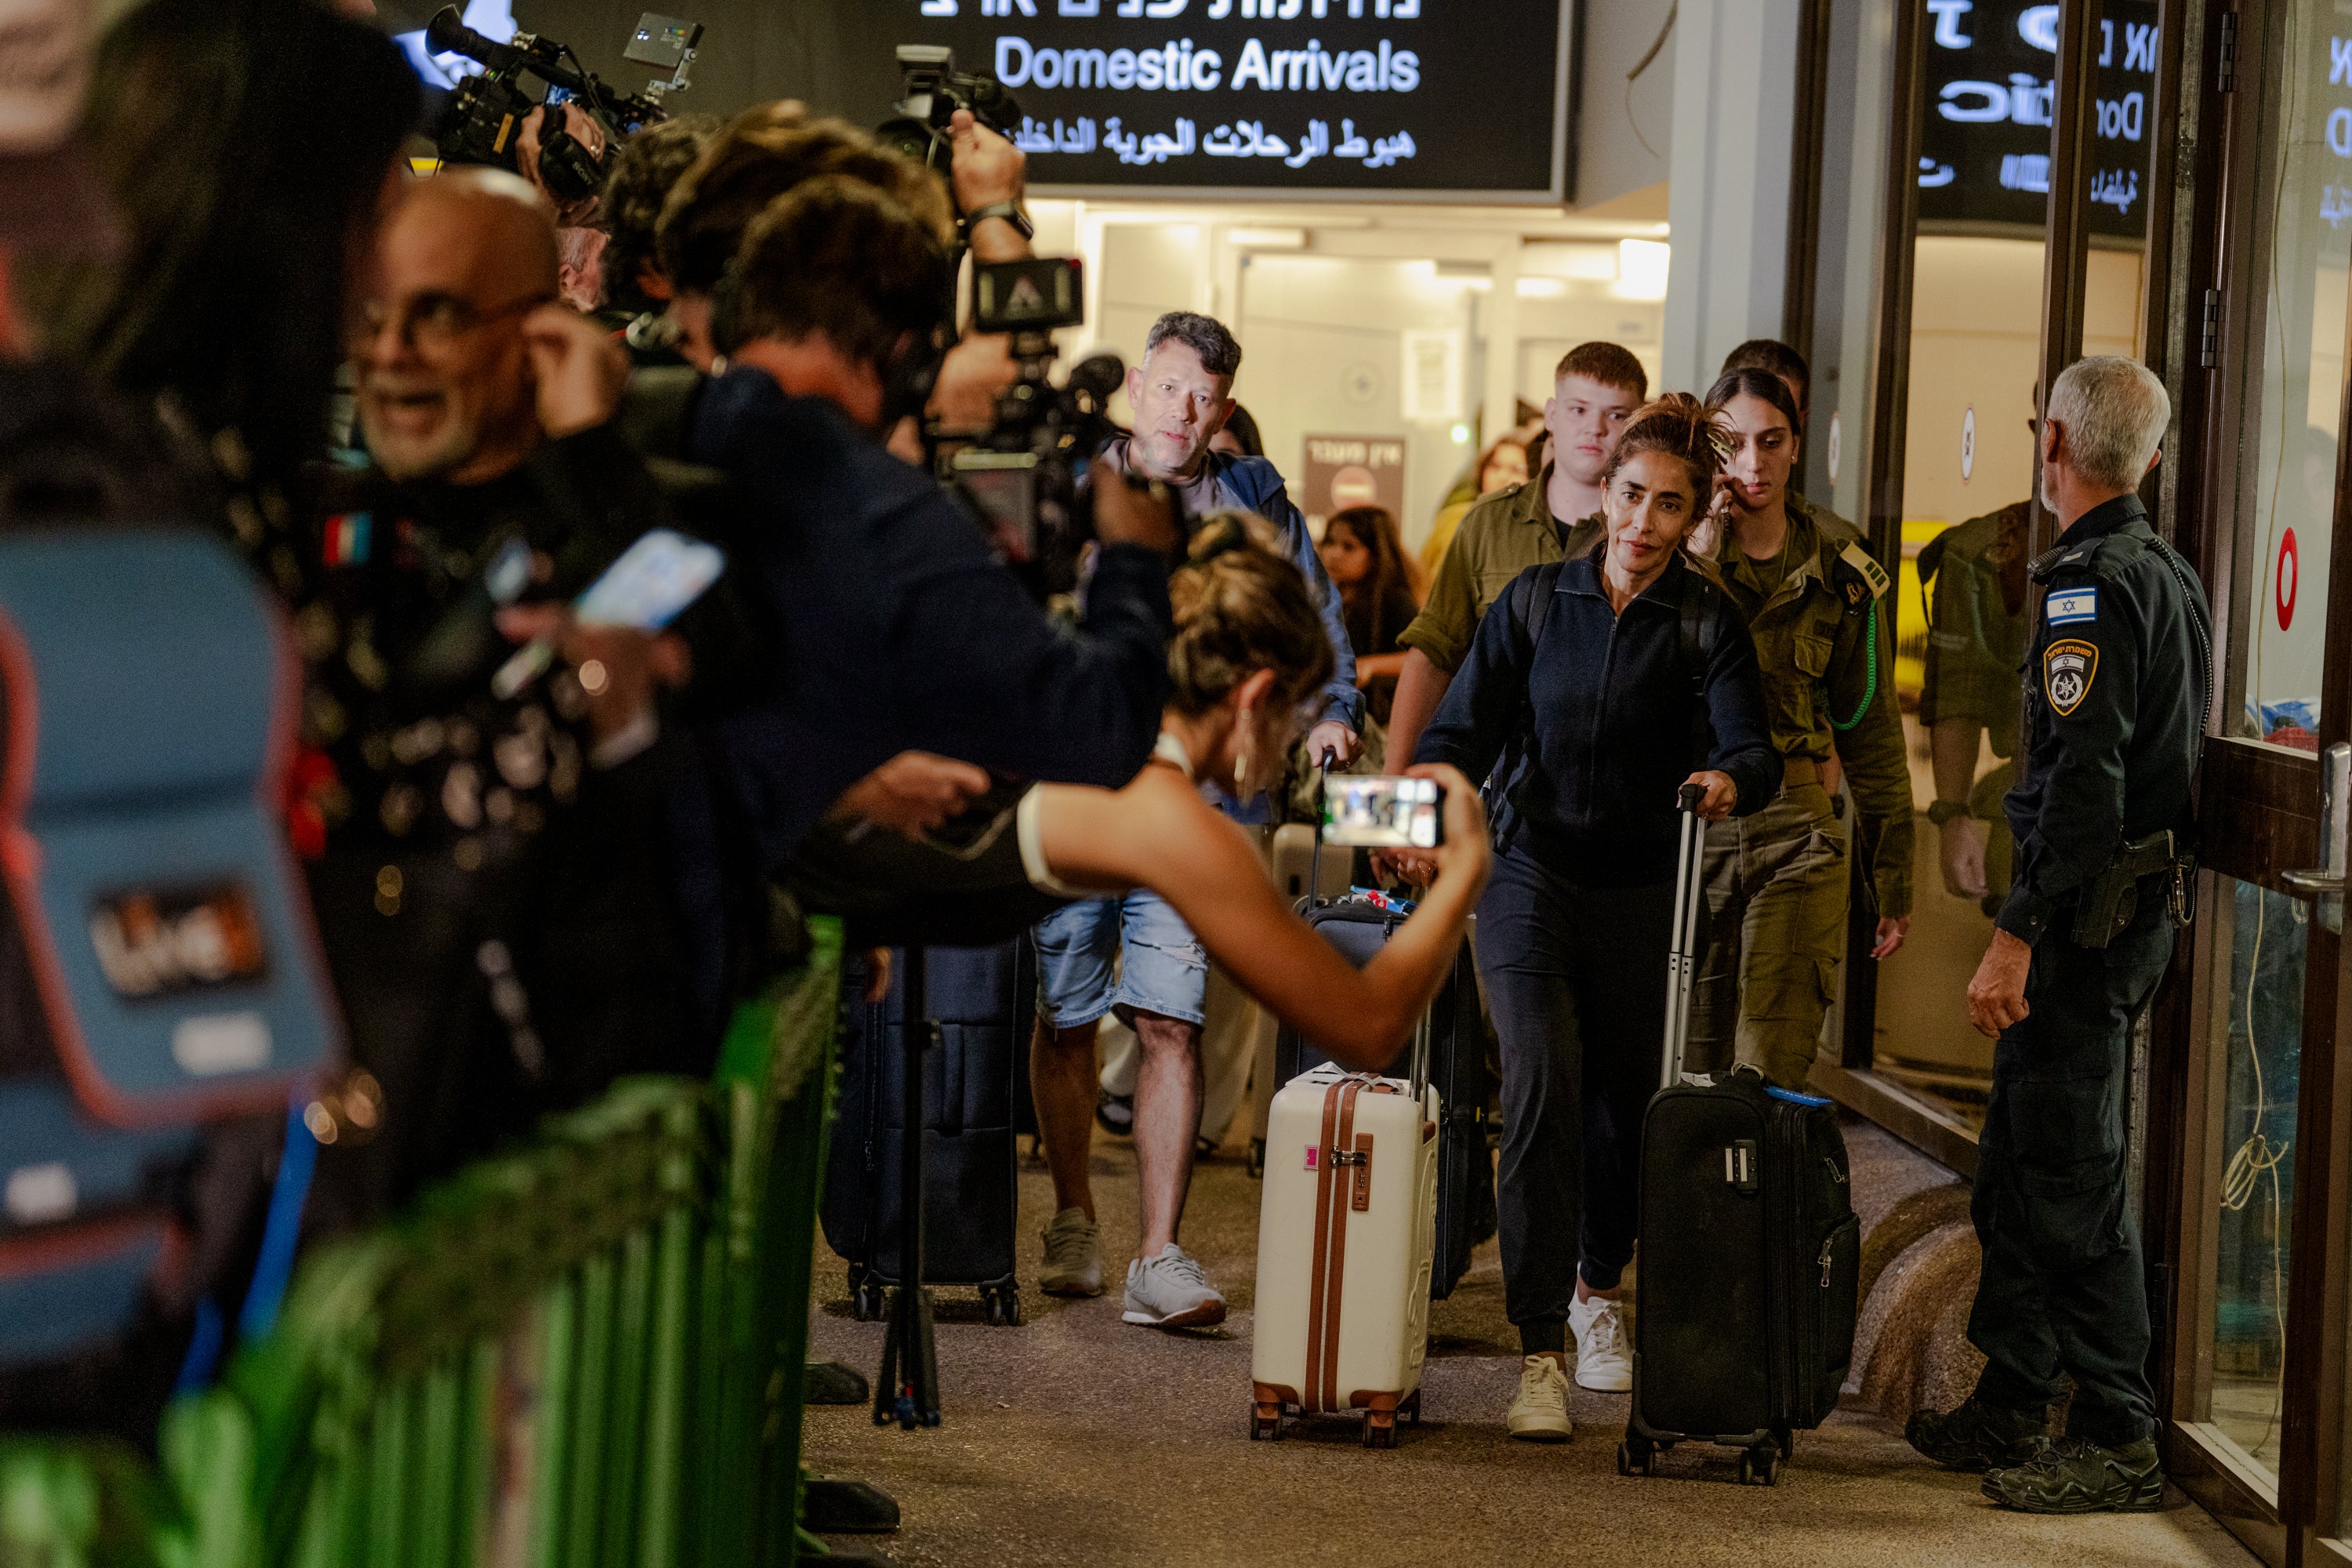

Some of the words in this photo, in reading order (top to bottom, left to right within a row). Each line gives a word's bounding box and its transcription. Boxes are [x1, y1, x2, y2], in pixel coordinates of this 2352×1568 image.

[995, 36, 1222, 91] Domestic
[1231, 38, 1421, 92] Arrivals
[1002, 115, 1098, 153] الداخل
[1103, 117, 1196, 165] الجوية
[1203, 119, 1330, 169] الرحلات
[1333, 118, 1417, 169] هبوط
[2047, 646, 2065, 661] ישראל
